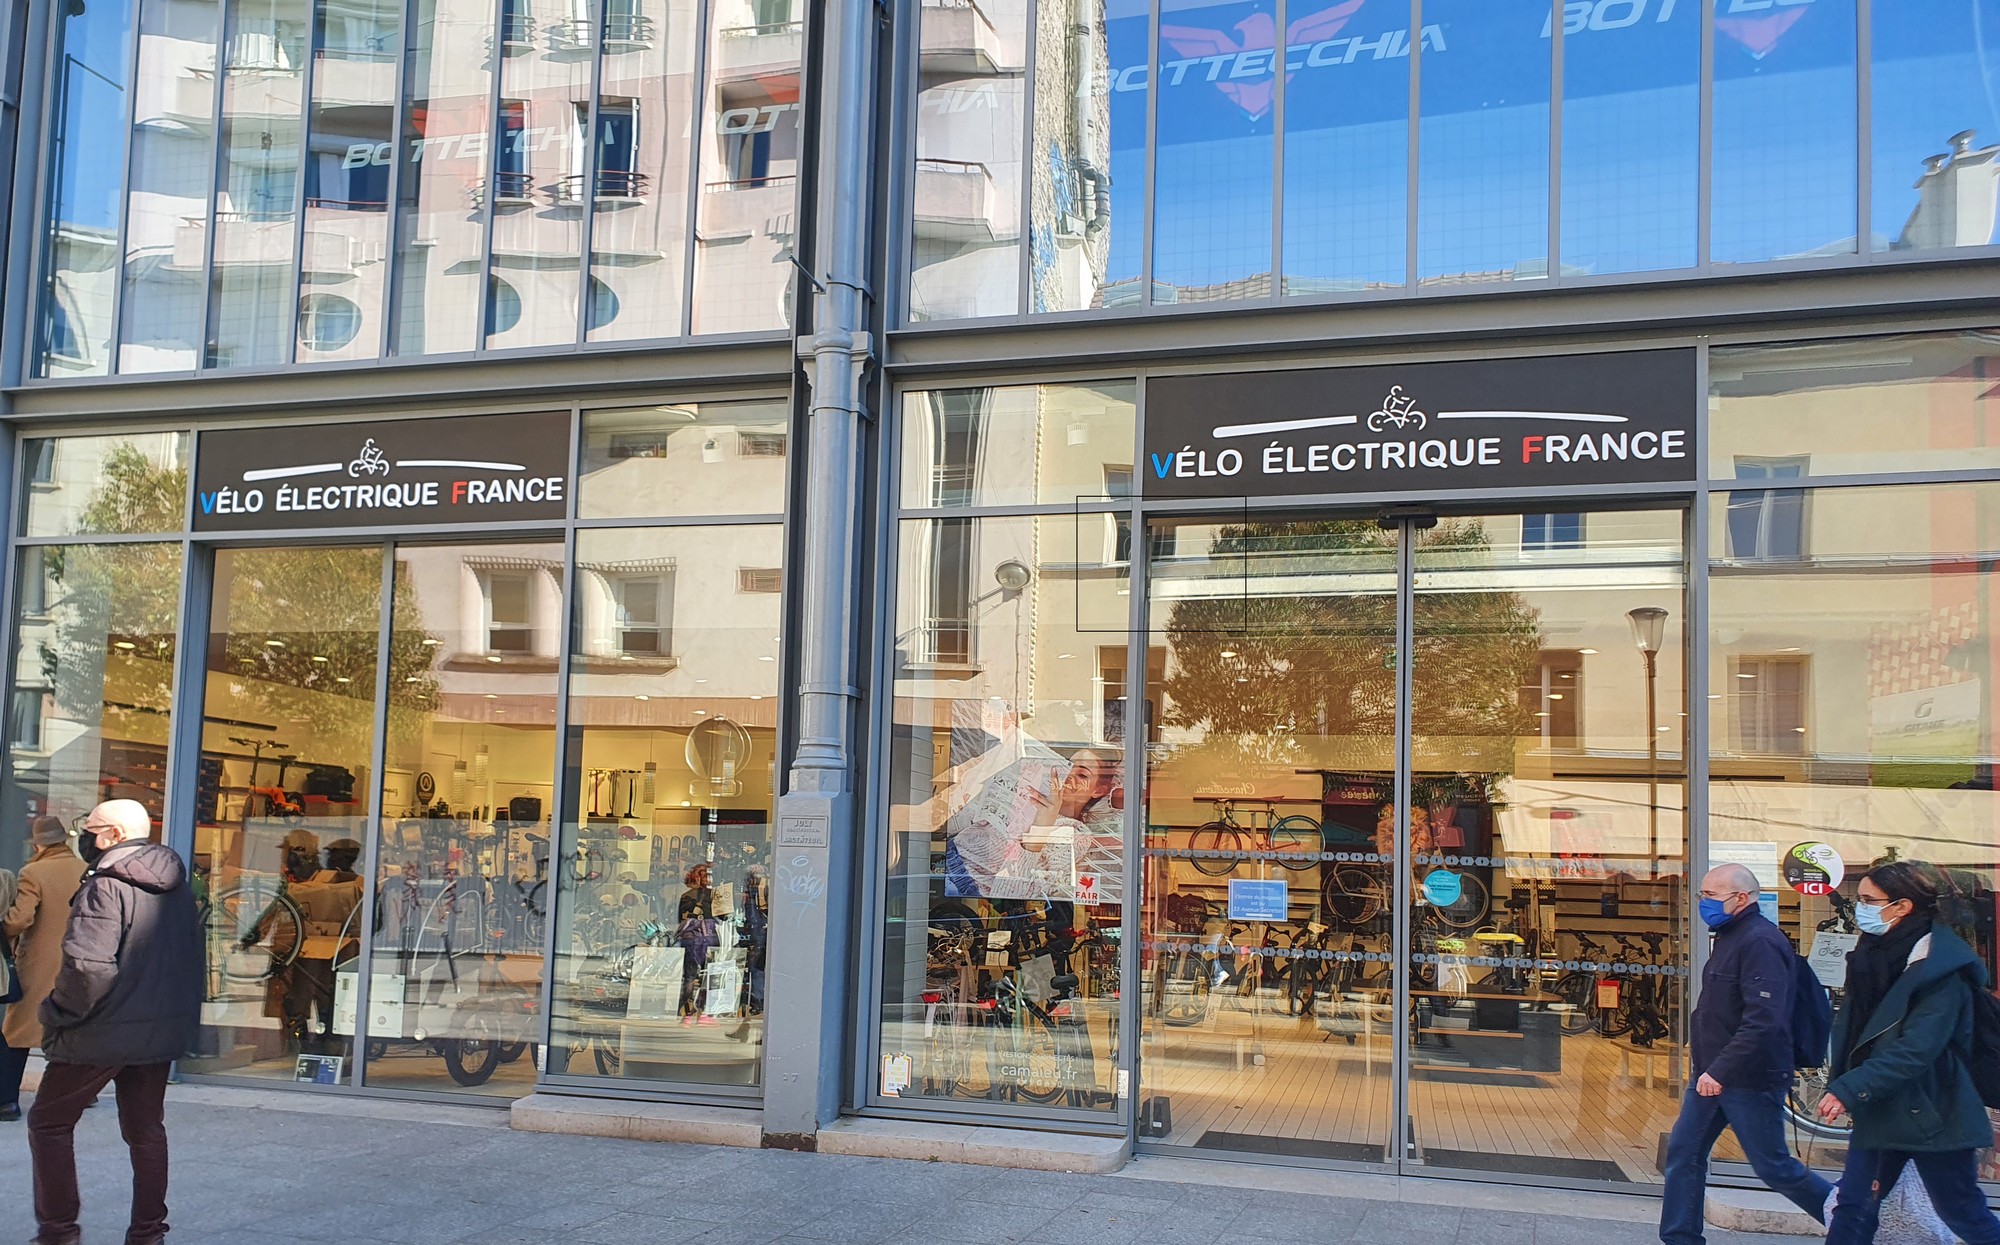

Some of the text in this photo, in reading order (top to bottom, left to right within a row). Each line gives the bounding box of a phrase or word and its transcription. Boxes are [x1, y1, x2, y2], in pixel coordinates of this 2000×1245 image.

[1151, 430, 1686, 479] VÉLO ÉLECTRIQUE FRANCE
[200, 477, 564, 515] VÉLO ÉLECTRIQUE FRANCE
[1075, 891, 1098, 900] FAIR
[1803, 882, 1823, 894] ICI
